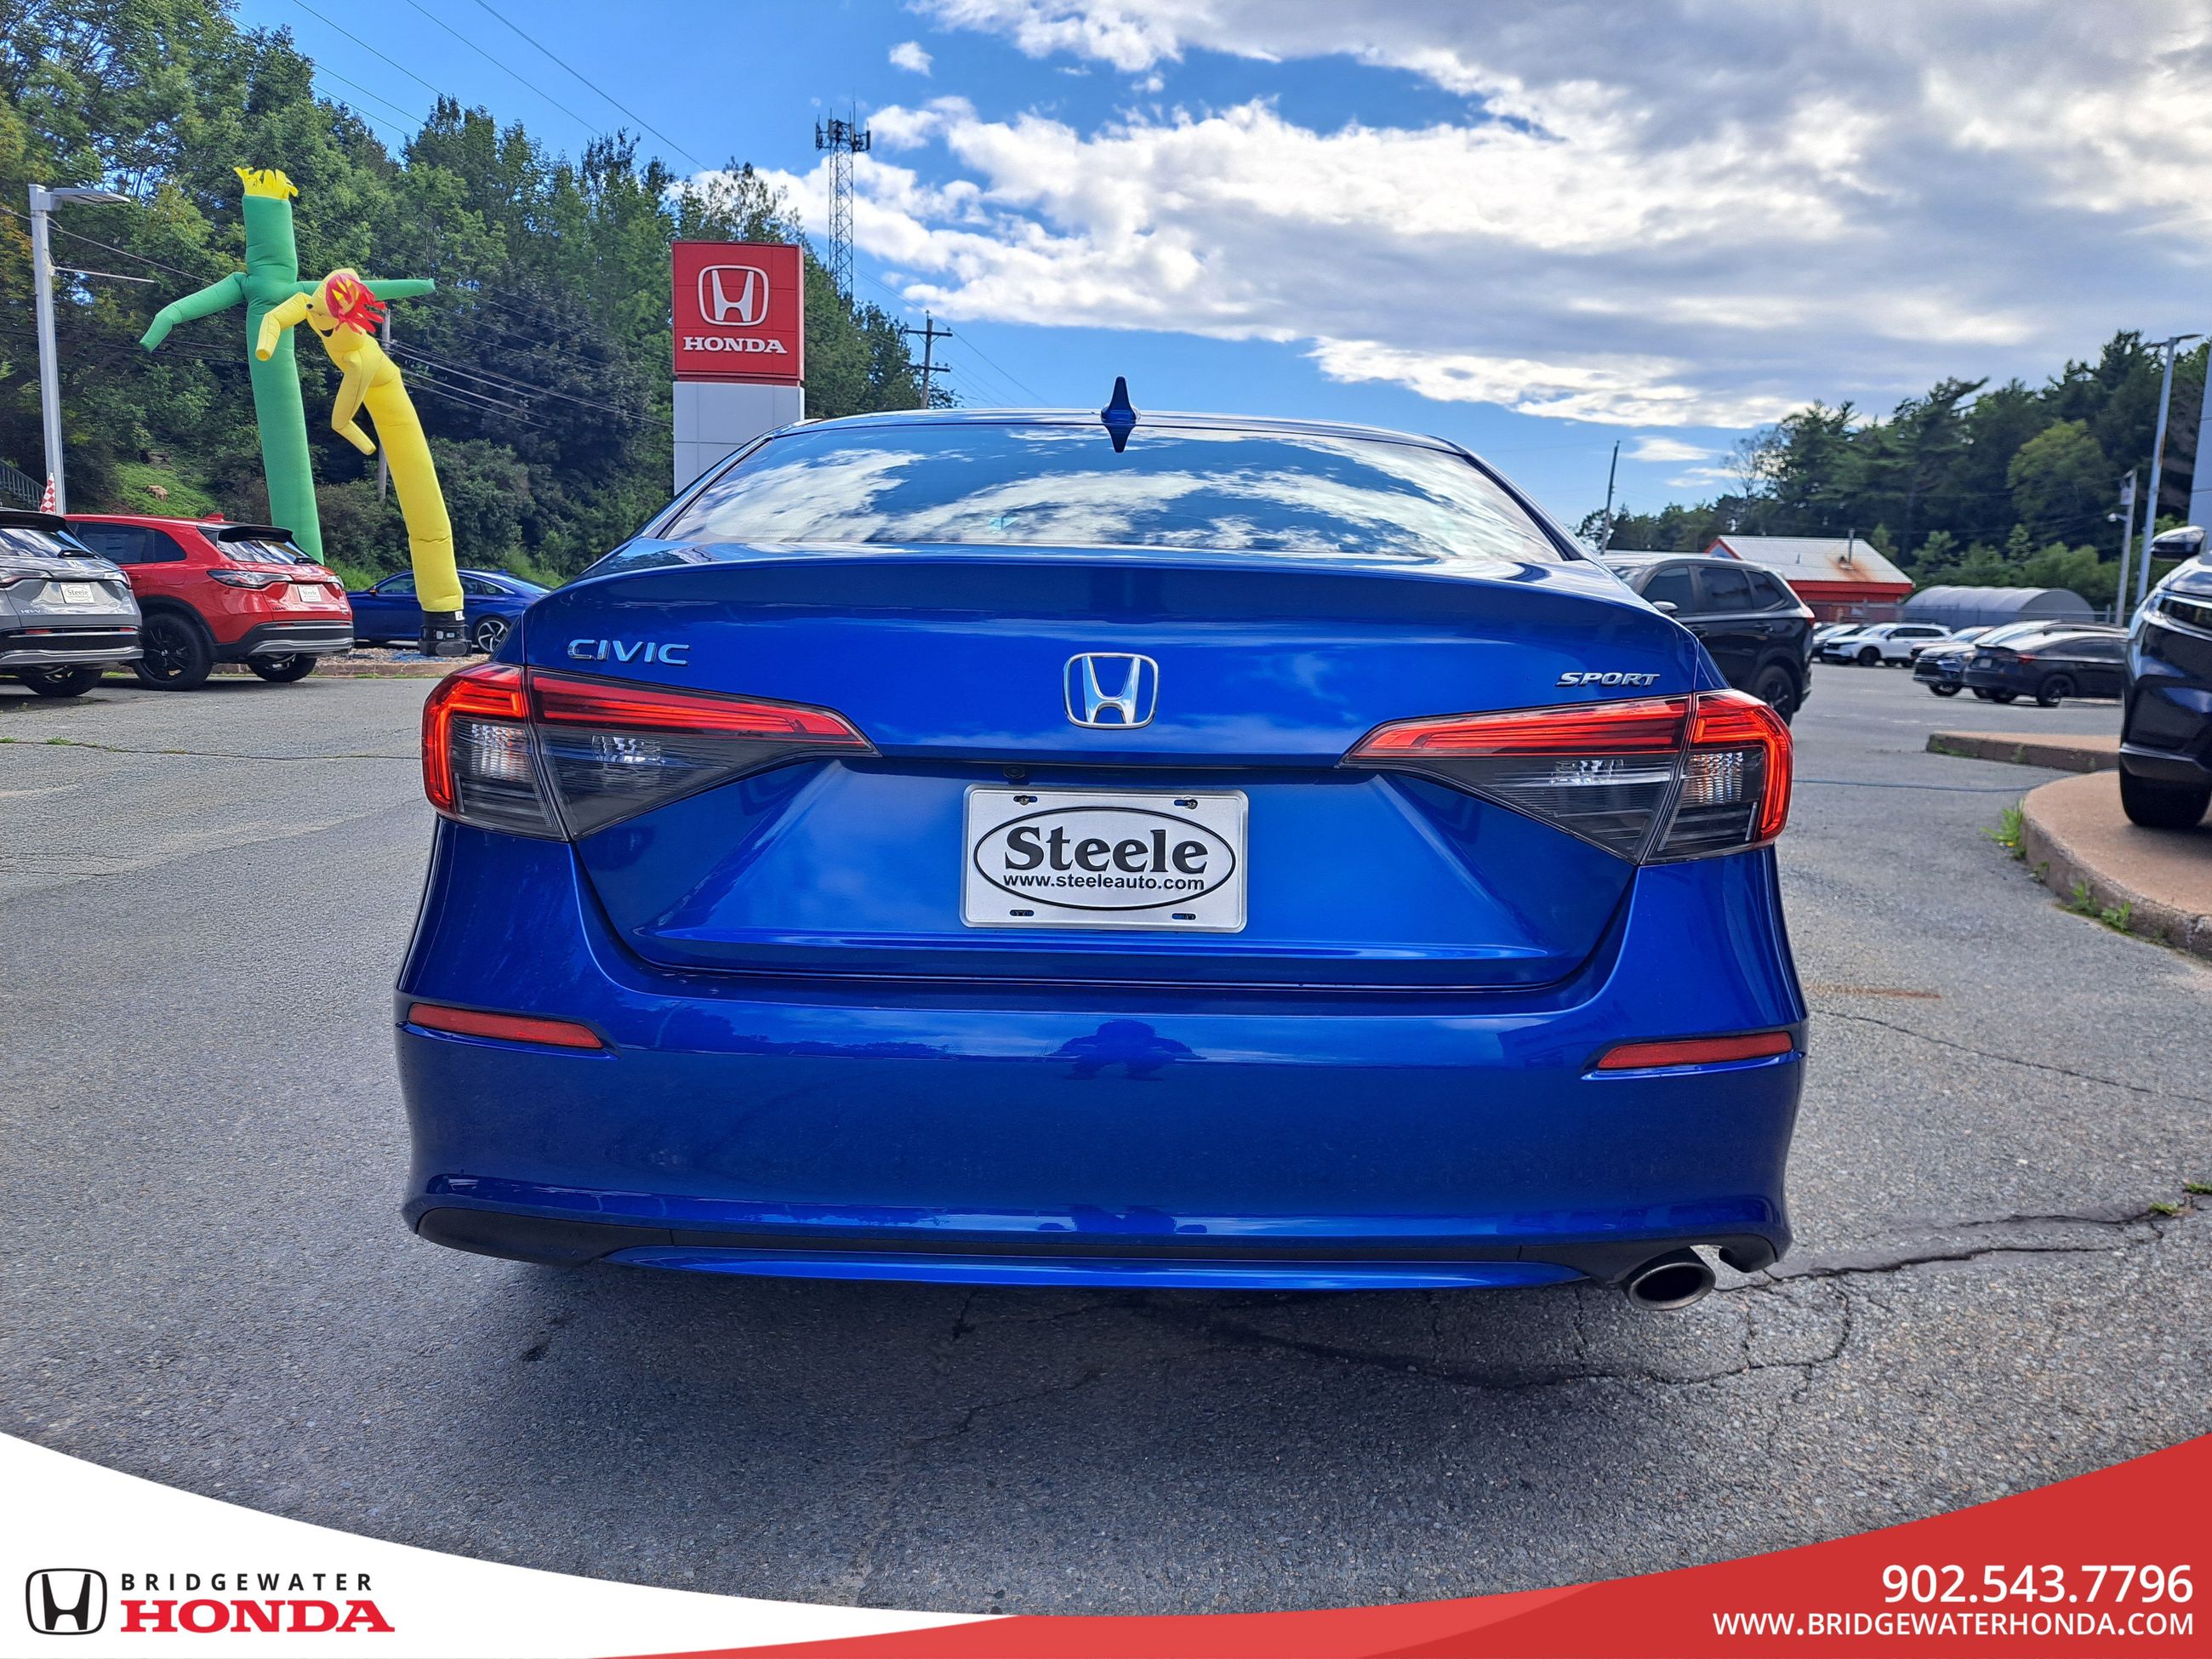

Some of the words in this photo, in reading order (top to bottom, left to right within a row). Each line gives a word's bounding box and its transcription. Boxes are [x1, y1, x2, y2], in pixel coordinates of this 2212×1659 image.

[683, 337, 788, 354] HONDA
[567, 639, 690, 665] CIVIC
[1556, 672, 1661, 687] SPORT
[1005, 825, 1208, 874] Steele
[1003, 874, 1205, 890] www.steeleauto.com
